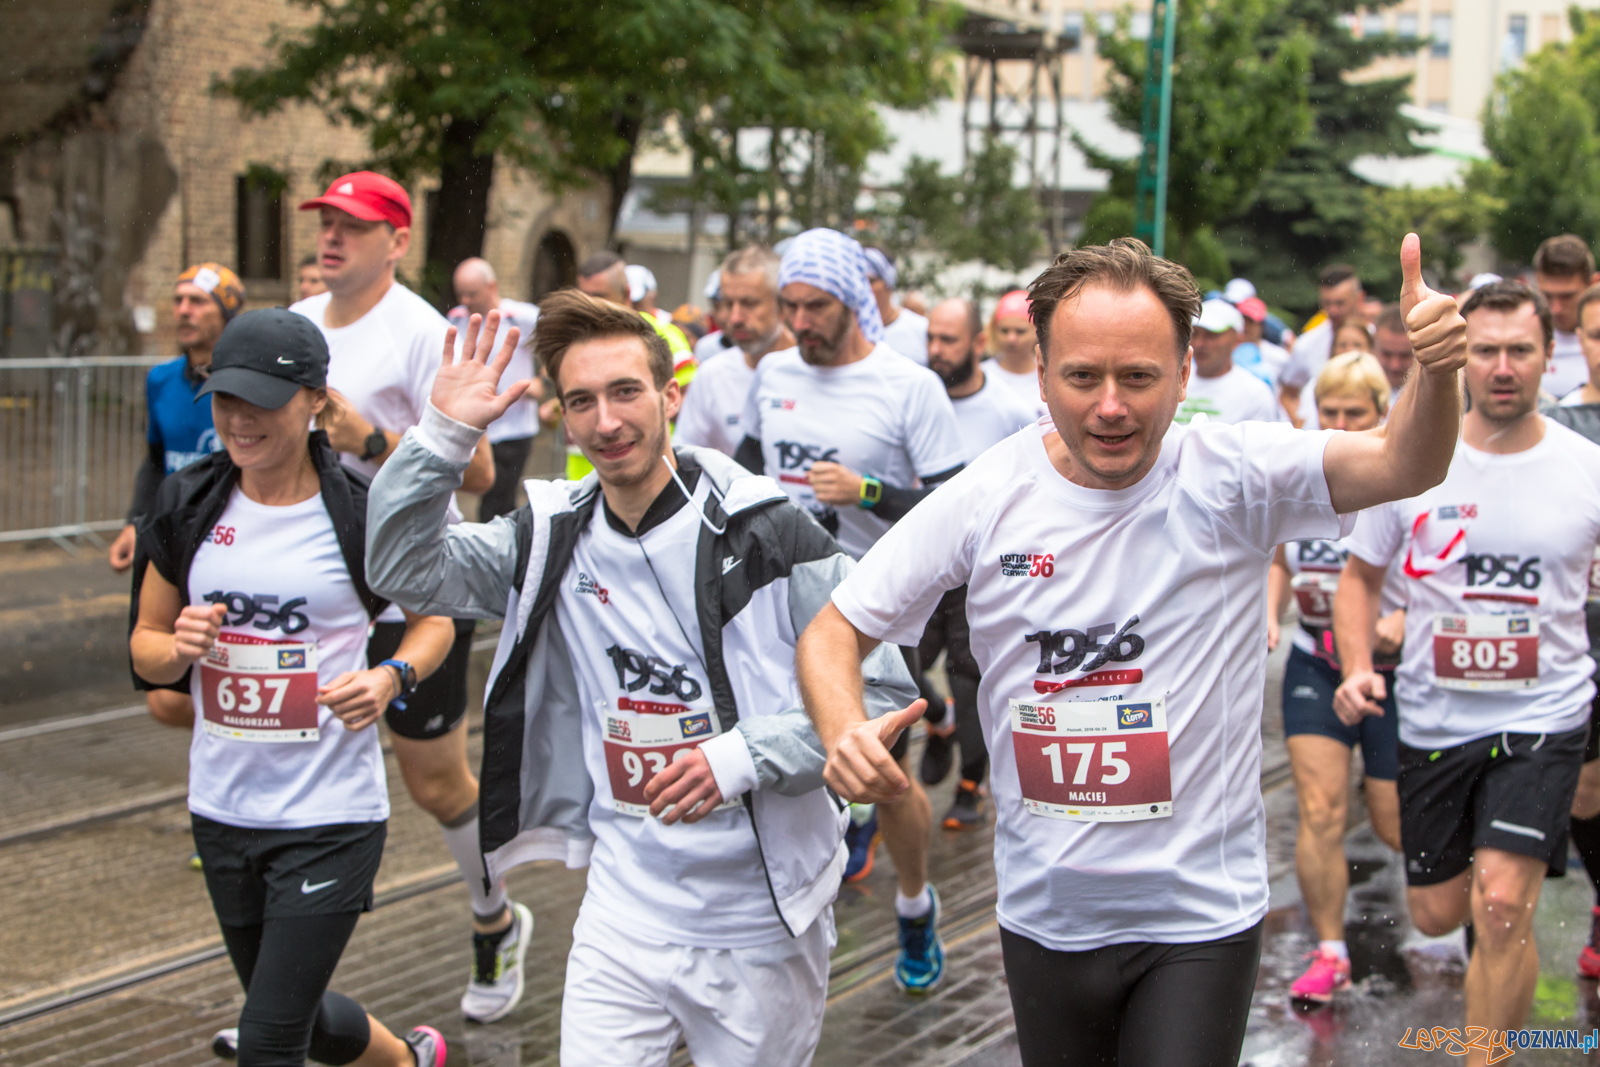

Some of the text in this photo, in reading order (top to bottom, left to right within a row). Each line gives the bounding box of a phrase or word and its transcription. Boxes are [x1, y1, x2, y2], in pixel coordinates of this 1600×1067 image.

[1000, 554, 1027, 563] LOTTO
[1458, 553, 1542, 590] 1956
[202, 589, 310, 635] 1956
[1025, 614, 1145, 675] 1956
[1452, 640, 1519, 669] 805
[605, 643, 702, 703] 1956
[1077, 674, 1128, 683] AMIĘCI
[216, 676, 291, 714] 637
[1018, 704, 1035, 712] LOTTO
[1126, 712, 1144, 723] LOTTO
[622, 747, 701, 787] 93
[1041, 740, 1131, 785] 175
[1068, 791, 1107, 804] MACIEJ
